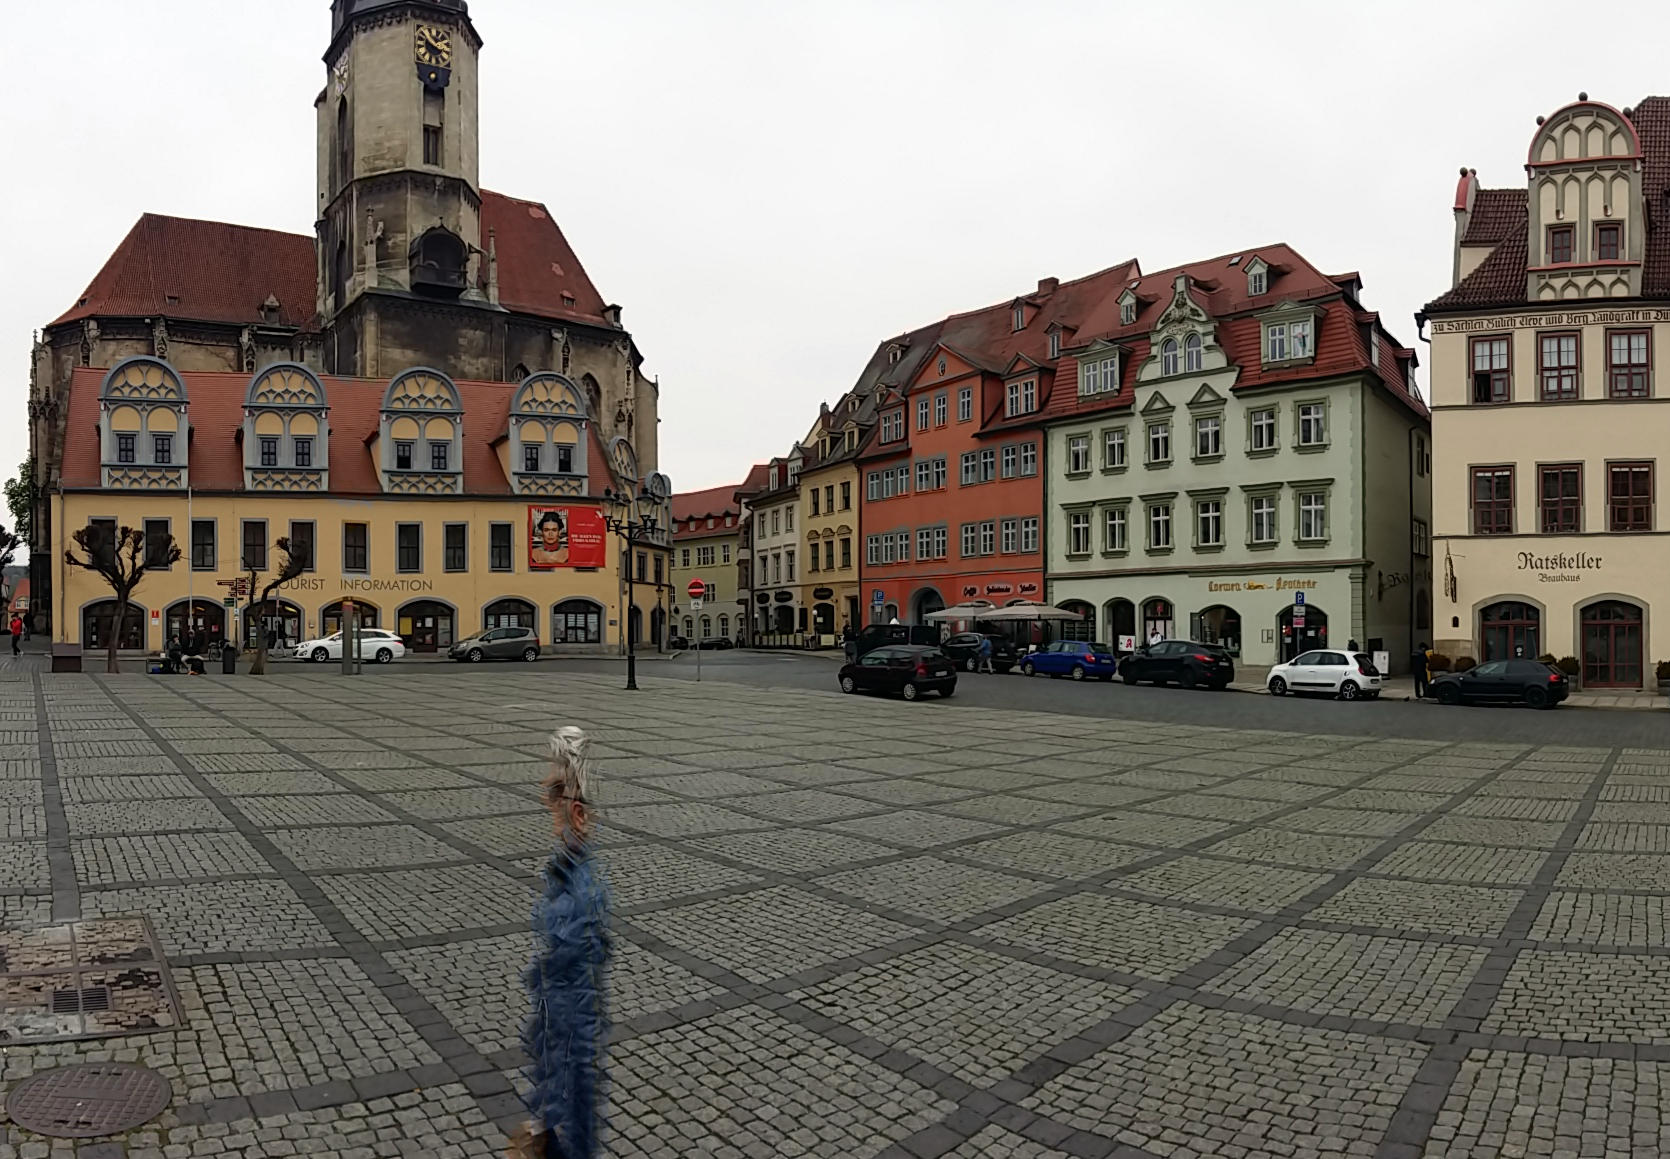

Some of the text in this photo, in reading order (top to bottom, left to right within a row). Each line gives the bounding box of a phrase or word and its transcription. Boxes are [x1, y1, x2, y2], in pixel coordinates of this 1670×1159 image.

[1545, 315, 1563, 325] und
[1517, 551, 1602, 570] Ratskeller
[1538, 572, 1581, 583] Brauhaus
[272, 578, 433, 592] OURIST INFORMATION
